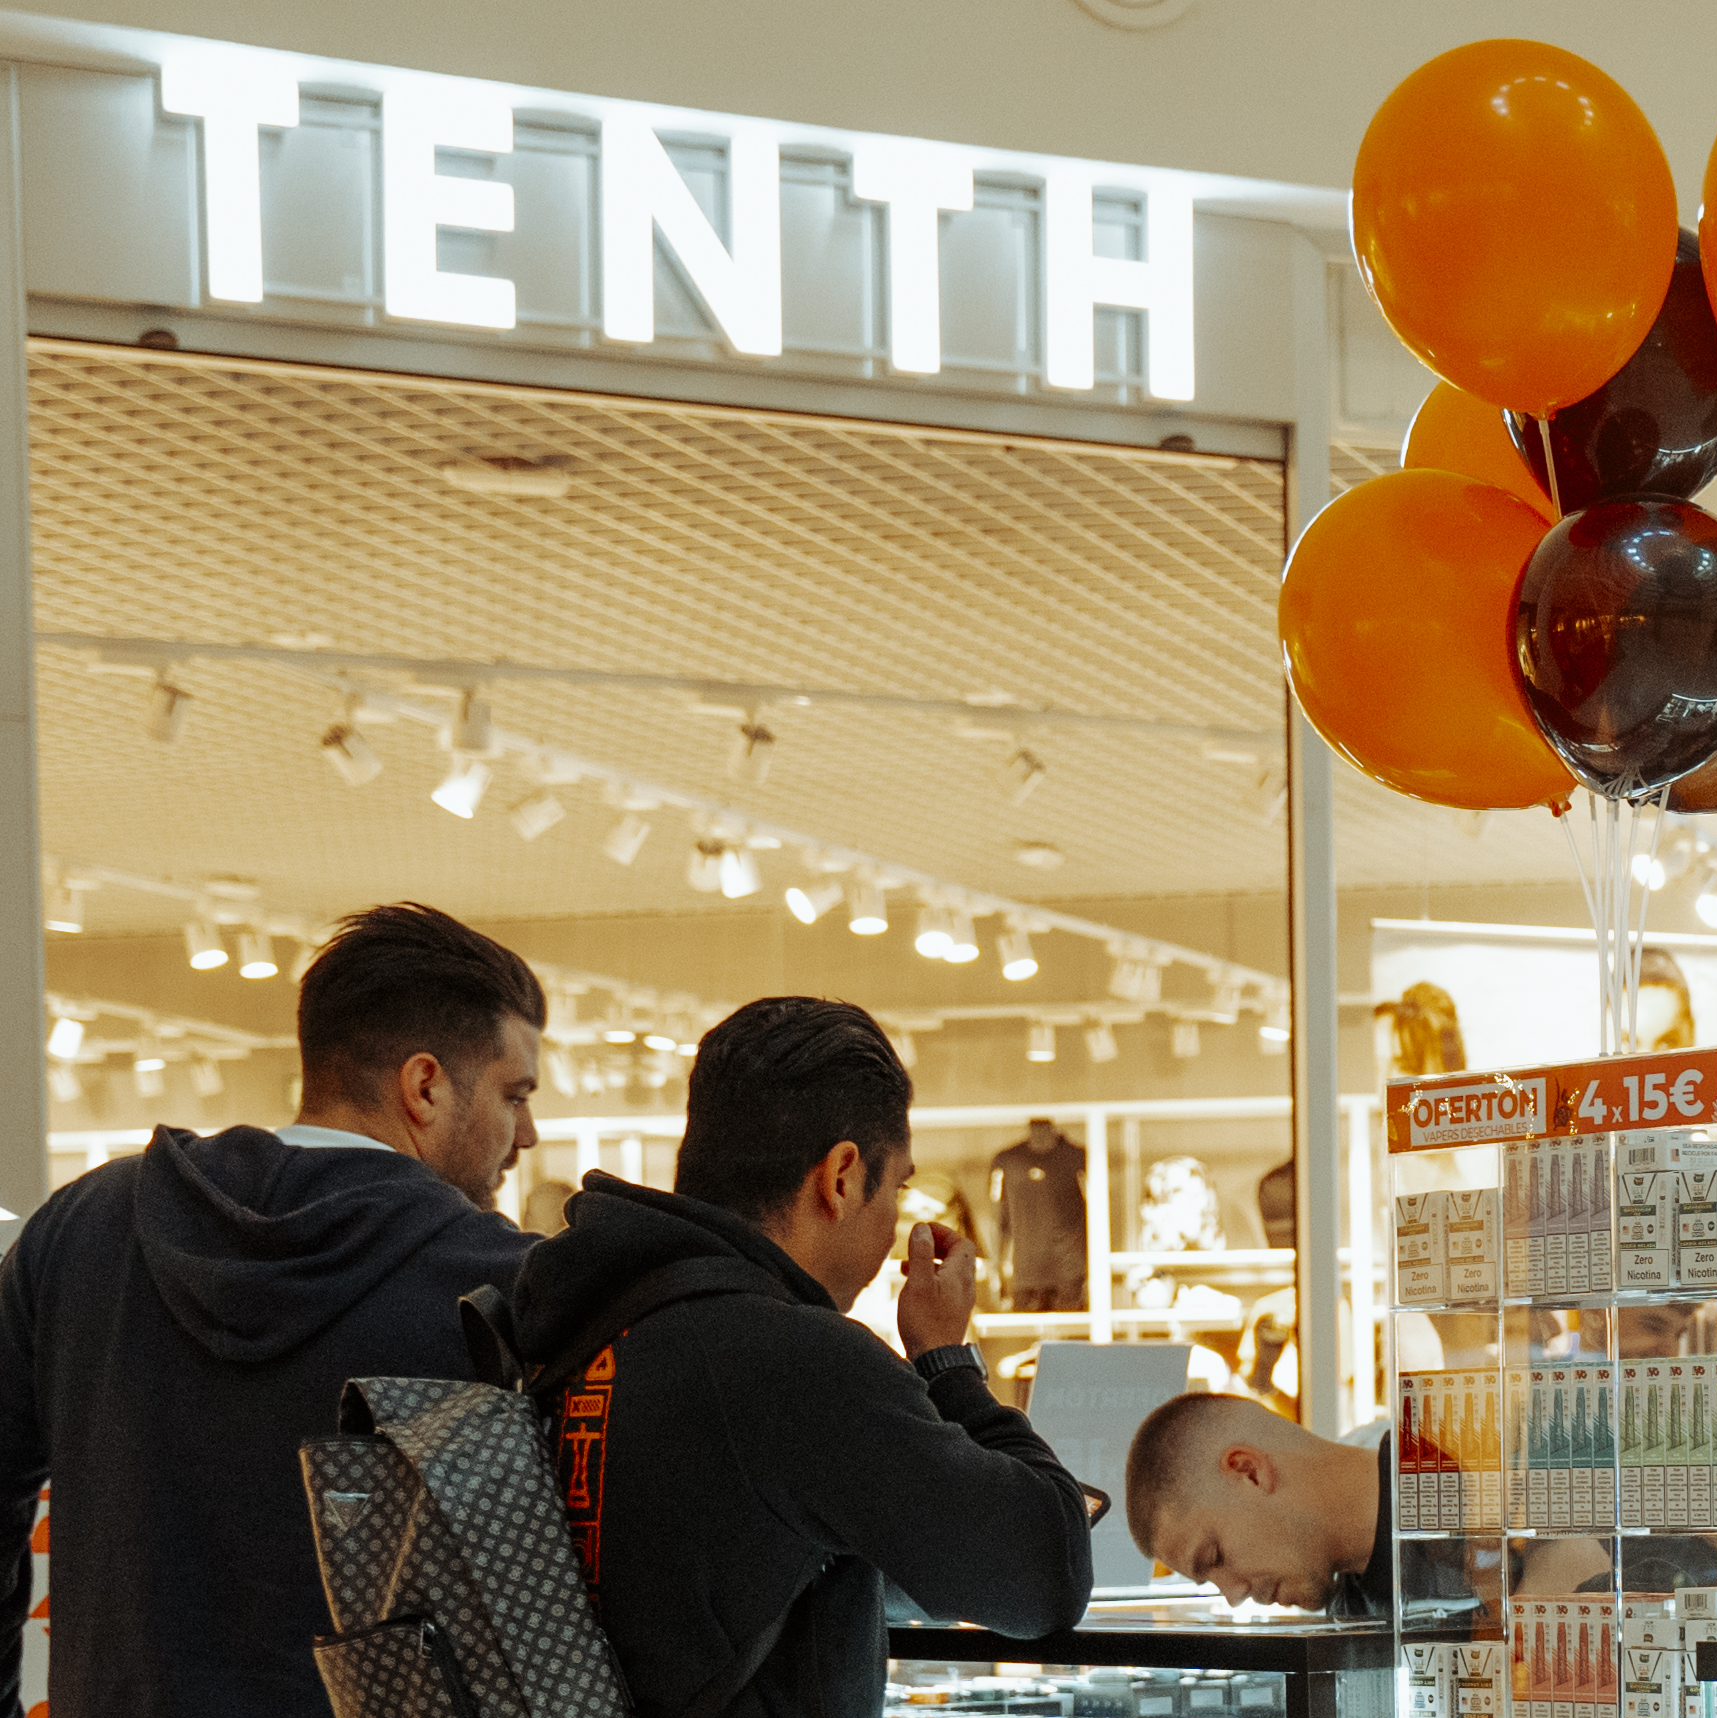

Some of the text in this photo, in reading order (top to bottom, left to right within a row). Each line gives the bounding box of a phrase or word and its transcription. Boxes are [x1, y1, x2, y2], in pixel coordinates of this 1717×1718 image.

[160, 45, 1195, 401] TENTH
[1423, 1124, 1528, 1142] VAPERS DESECHABLES
[1634, 1254, 1653, 1265] Zero
[1695, 1252, 1714, 1263] Zero
[1411, 1271, 1429, 1281] Zero
[1464, 1268, 1482, 1278] Zero
[1627, 1270, 1661, 1280] Nicotina
[1405, 1285, 1437, 1297] Nicotina
[1457, 1283, 1489, 1294] Nicotina
